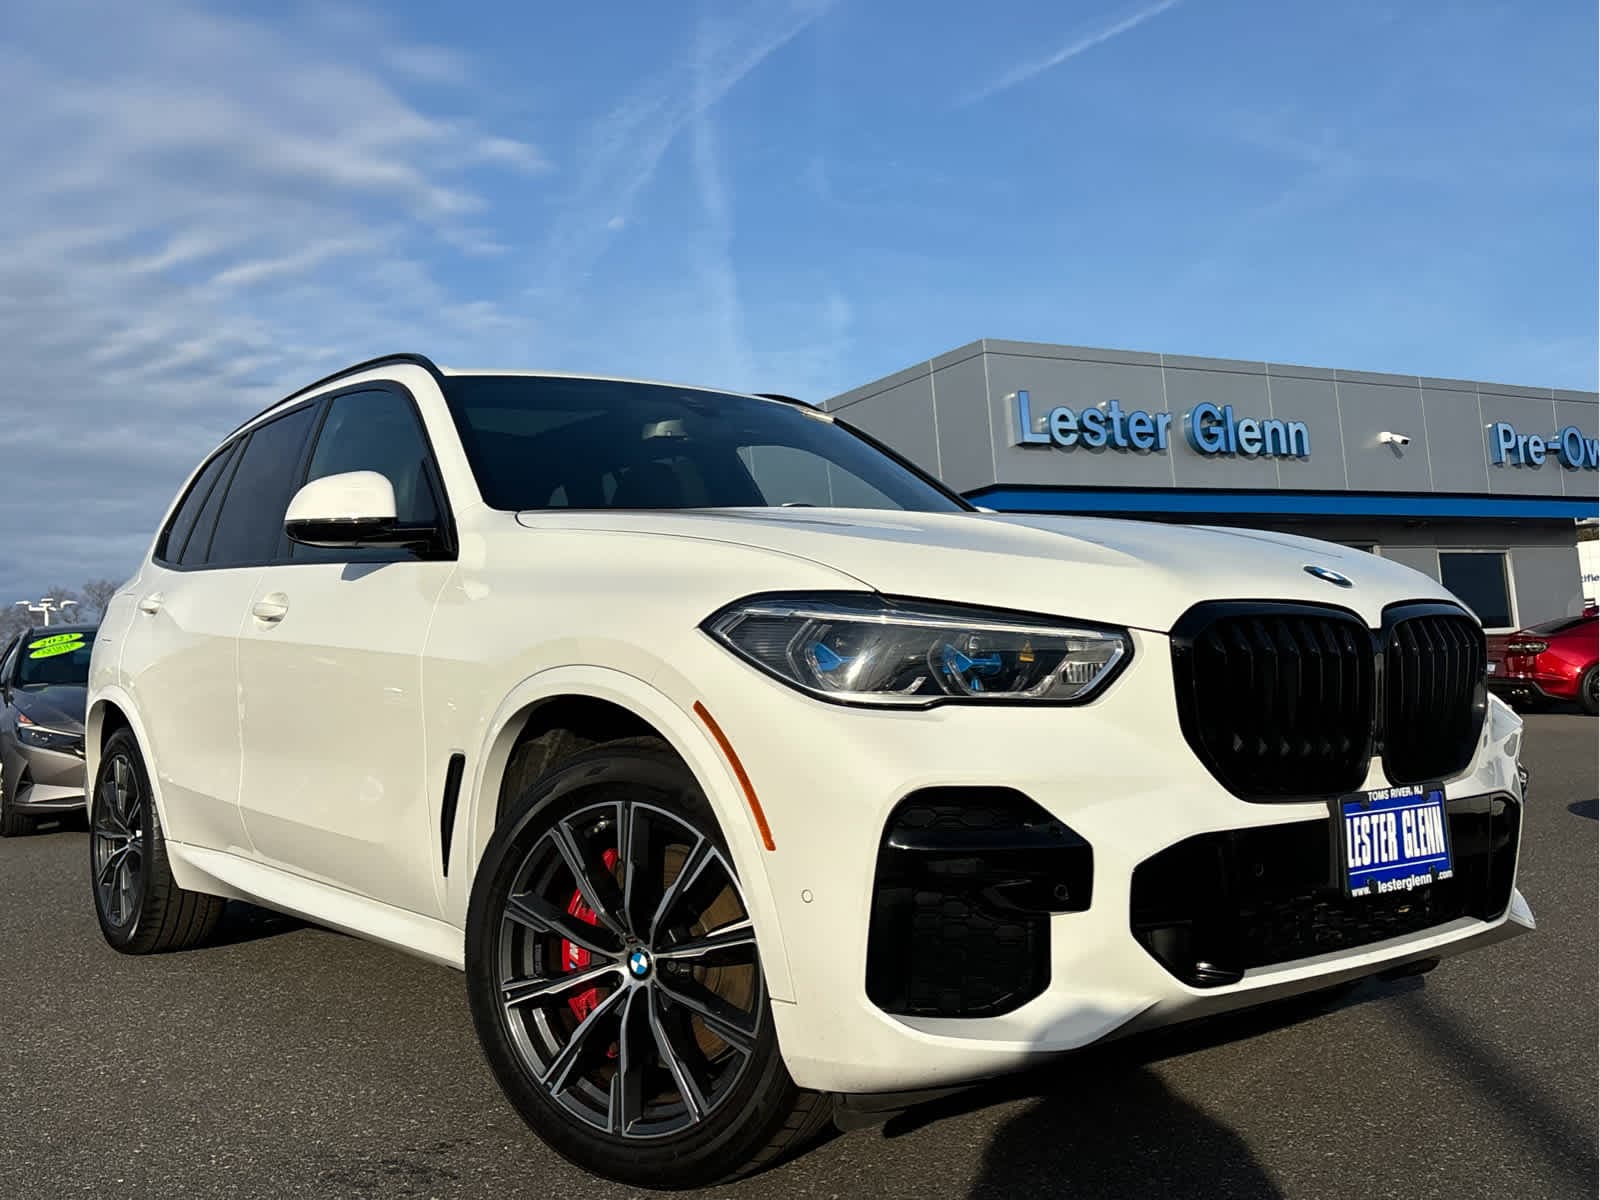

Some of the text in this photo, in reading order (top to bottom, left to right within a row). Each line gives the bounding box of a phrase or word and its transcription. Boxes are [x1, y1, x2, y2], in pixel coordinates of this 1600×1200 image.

[1006, 390, 1311, 457] Lester Glenn
[1368, 790, 1389, 801] TOMS
[1414, 785, 1423, 795] NJ
[1346, 806, 1445, 868] LESTER GLENN
[1378, 874, 1432, 893] lesterglenn
